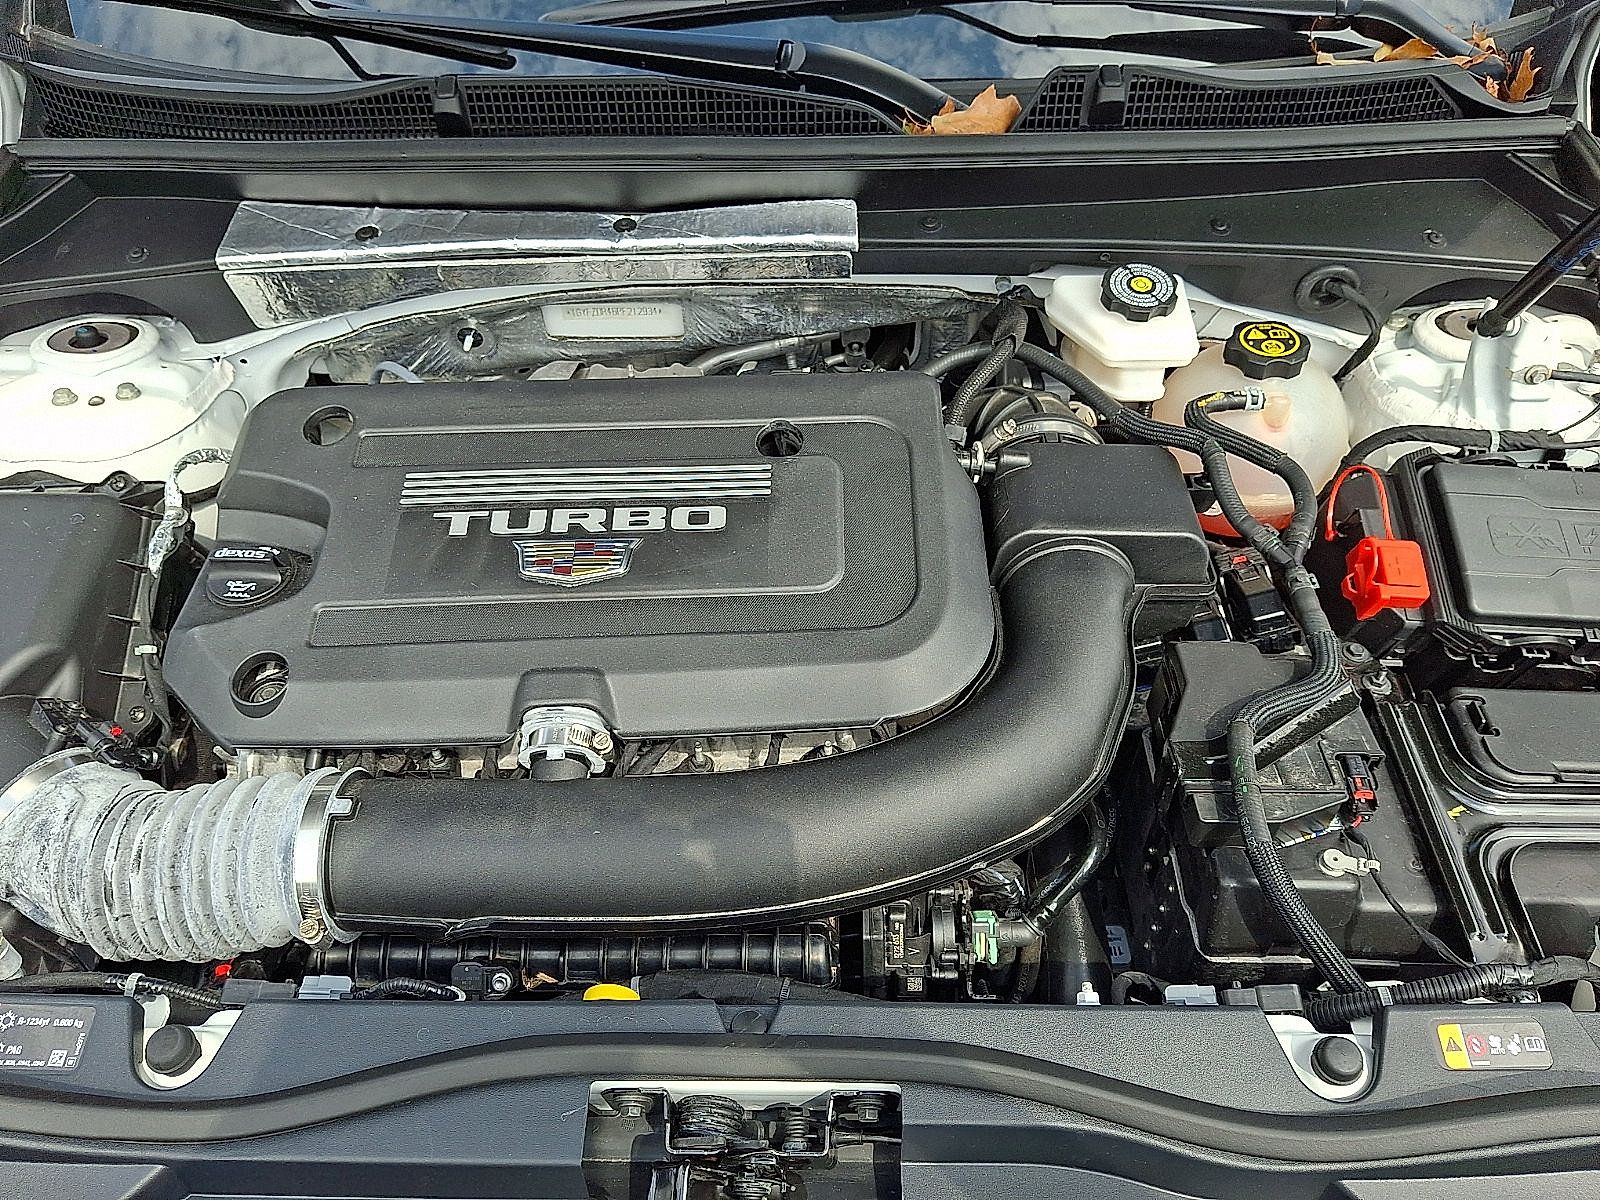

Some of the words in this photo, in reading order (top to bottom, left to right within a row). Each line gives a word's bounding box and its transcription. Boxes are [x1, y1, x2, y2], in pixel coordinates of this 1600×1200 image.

[433, 505, 727, 537] TURBO
[214, 547, 268, 559] dexos
[5, 1045, 23, 1055] PAG
